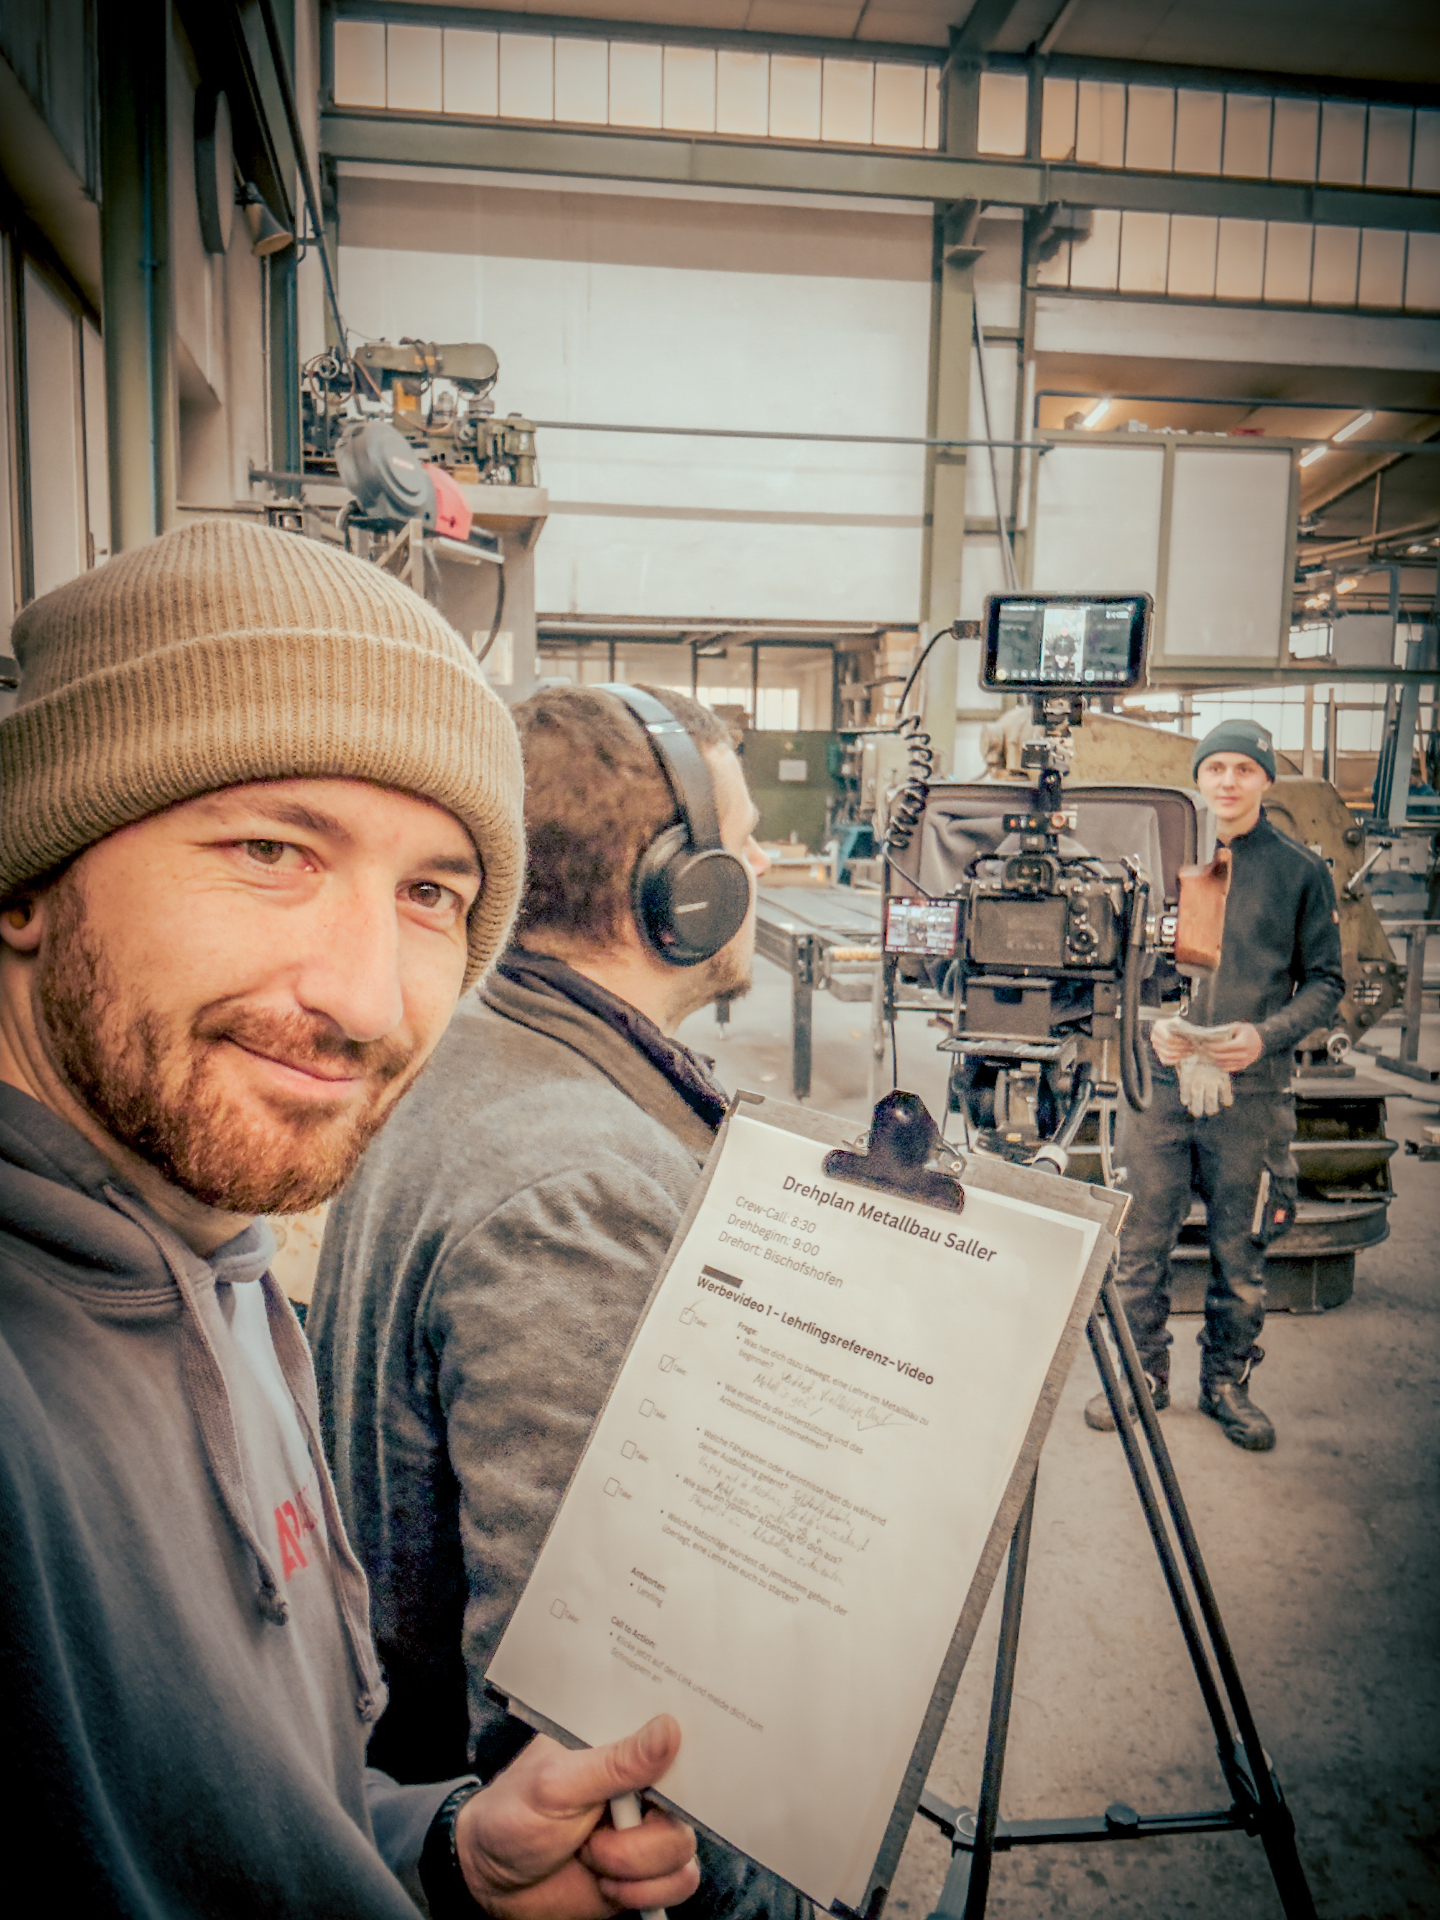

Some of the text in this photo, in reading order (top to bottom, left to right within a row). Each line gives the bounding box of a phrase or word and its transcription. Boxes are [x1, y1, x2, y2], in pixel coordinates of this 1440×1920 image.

[727, 1213, 820, 1257] Drehbeginn: 9:00
[735, 1195, 817, 1234] Crew-Call: 8:30
[782, 1176, 997, 1261] Drehplan Metallbau Saller
[718, 1230, 843, 1287] Drehort: Bischofshofen
[697, 1276, 765, 1313] Werbevideo
[781, 1313, 934, 1385] Lehrlingsreferenz-Video
[738, 1348, 775, 1368] beginnen?
[743, 1337, 758, 1350] Was
[758, 1344, 771, 1356] hat
[770, 1350, 787, 1362] dich
[786, 1357, 804, 1370] dazu
[832, 1378, 849, 1390] eine
[847, 1384, 870, 1399] Lehre
[869, 1394, 881, 1404] im
[881, 1398, 919, 1422] Metallbau
[918, 1416, 930, 1426] zu
[724, 1383, 738, 1395] Wie
[761, 1401, 772, 1412] du
[771, 1406, 784, 1417] die
[784, 1412, 834, 1443] Unterstützung
[833, 1436, 850, 1448] und
[848, 1443, 864, 1455] das
[765, 1417, 777, 1428] im
[776, 1423, 829, 1450] Unternehmen?
[703, 1429, 887, 1527] Welche Fähigkeiten oder Kenntnisse hast du während
[720, 1452, 759, 1479] Ausbildung
[682, 1476, 696, 1489] Wie
[713, 1493, 725, 1504] ein
[757, 1516, 796, 1543] Arbeitstag
[806, 1542, 824, 1556] dich
[823, 1551, 843, 1565] aus?
[630, 1567, 666, 1592] Antworten:
[667, 1512, 693, 1531] Welche
[758, 1563, 770, 1574] du
[833, 1604, 848, 1616] der
[692, 1542, 708, 1555] eine
[707, 1549, 728, 1566] Lehre
[727, 1560, 740, 1573] bei
[739, 1568, 758, 1583] euch
[757, 1578, 768, 1589] zu
[768, 1584, 800, 1604] starten?
[610, 1615, 625, 1629] Call
[624, 1624, 632, 1634] to
[651, 1658, 665, 1670] auf
[663, 1665, 678, 1678] den
[691, 1684, 708, 1697] und
[729, 1706, 747, 1722] dich
[746, 1717, 764, 1733] zum
